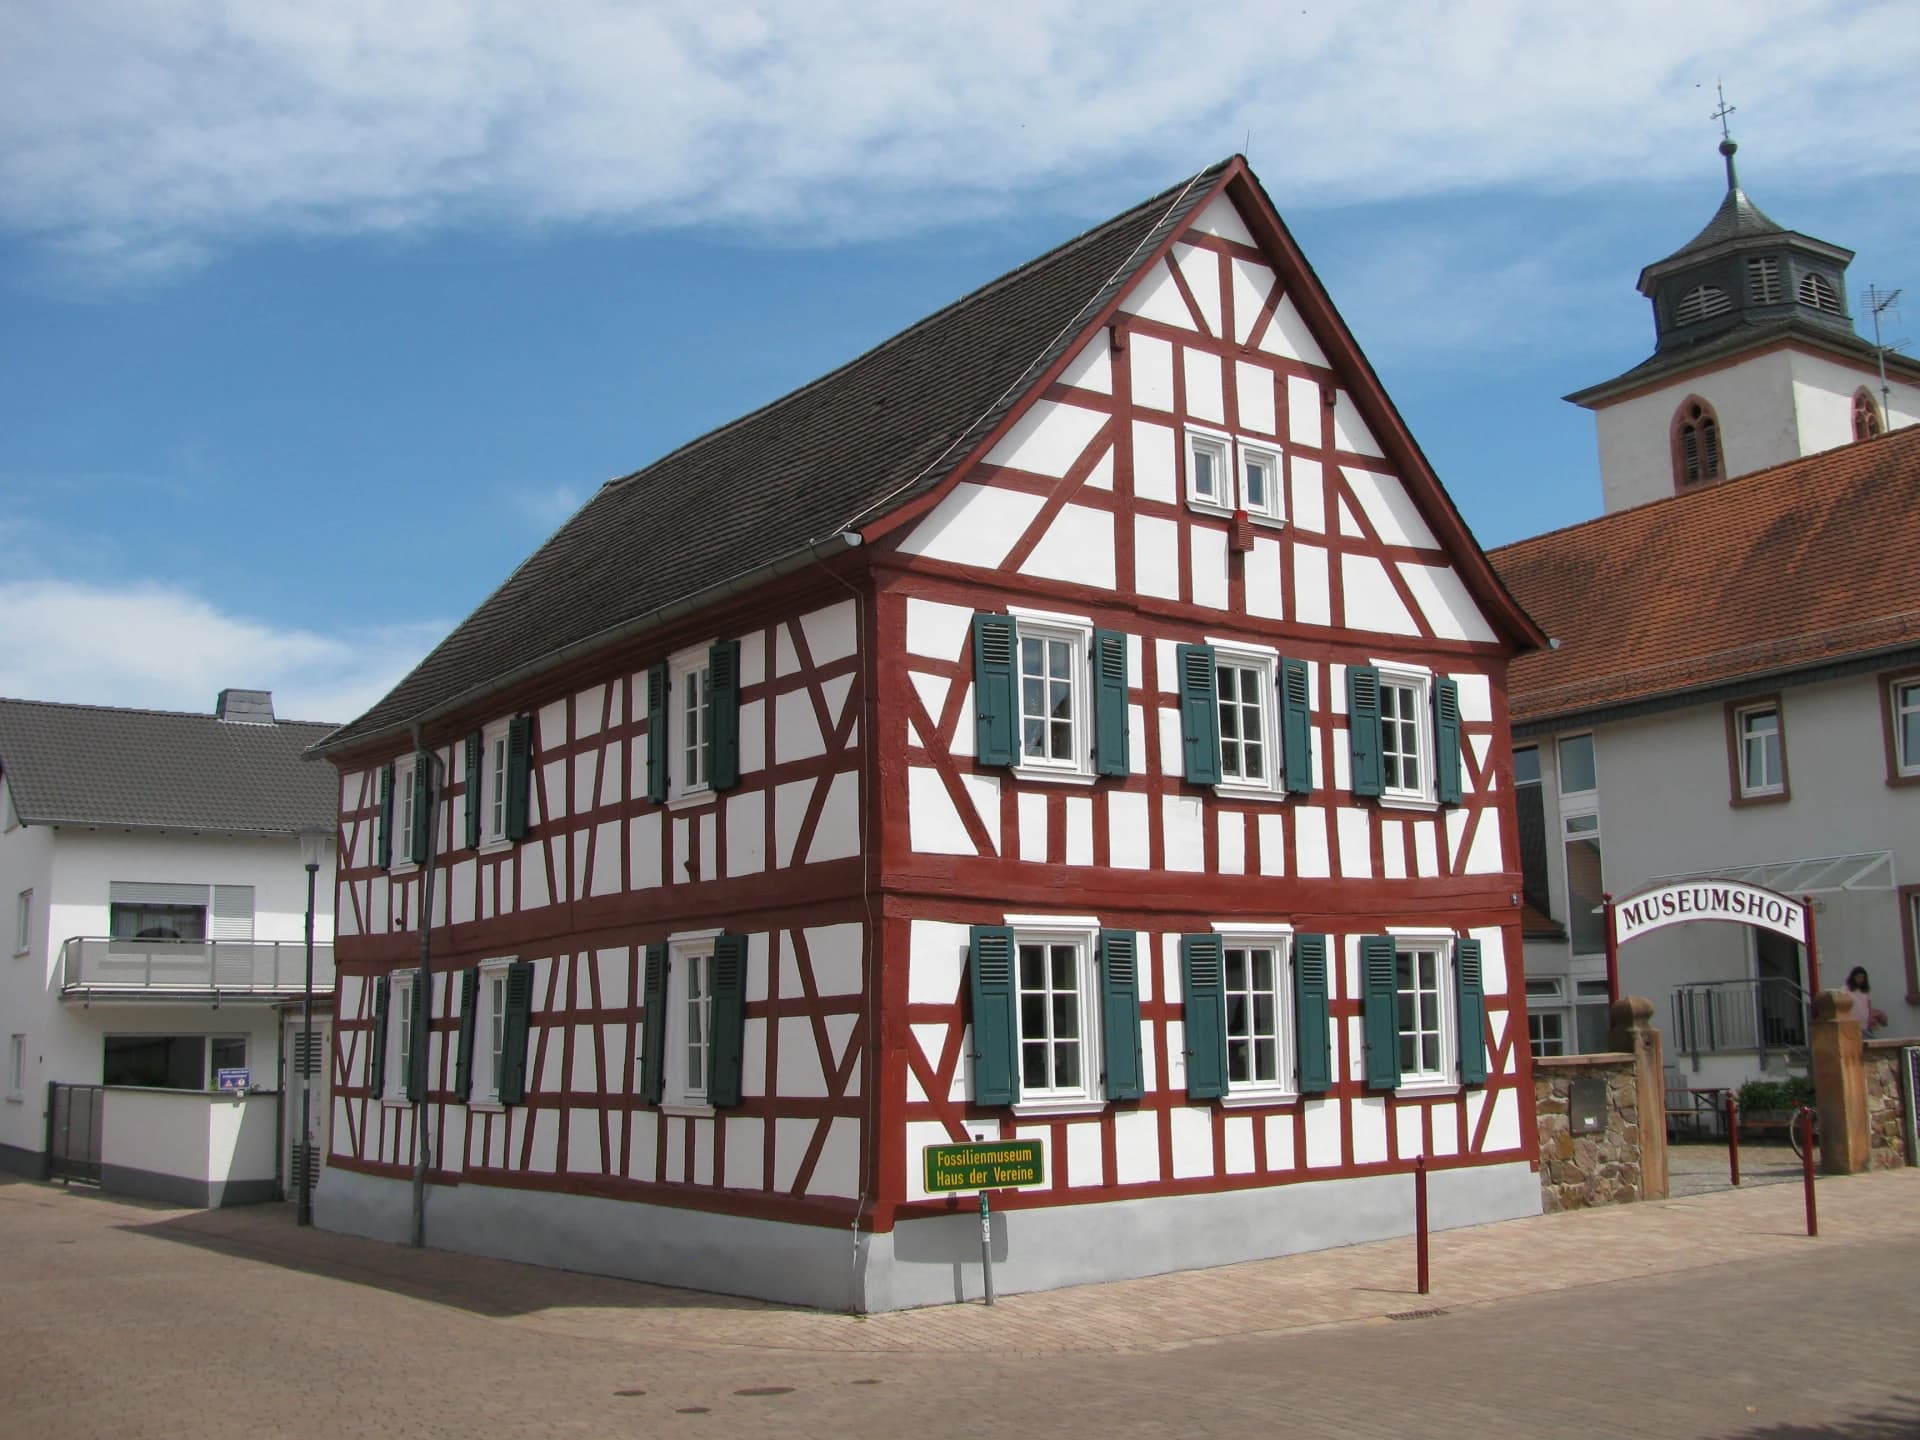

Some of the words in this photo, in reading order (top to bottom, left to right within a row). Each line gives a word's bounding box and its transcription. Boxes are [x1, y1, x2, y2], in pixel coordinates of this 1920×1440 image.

[1622, 888, 1798, 930] MUSEUMSHOF
[937, 1149, 1032, 1167] Fossilienmuseum
[937, 1169, 964, 1186] Haus
[969, 1167, 988, 1184] der
[994, 1165, 1034, 1182] Vereine
